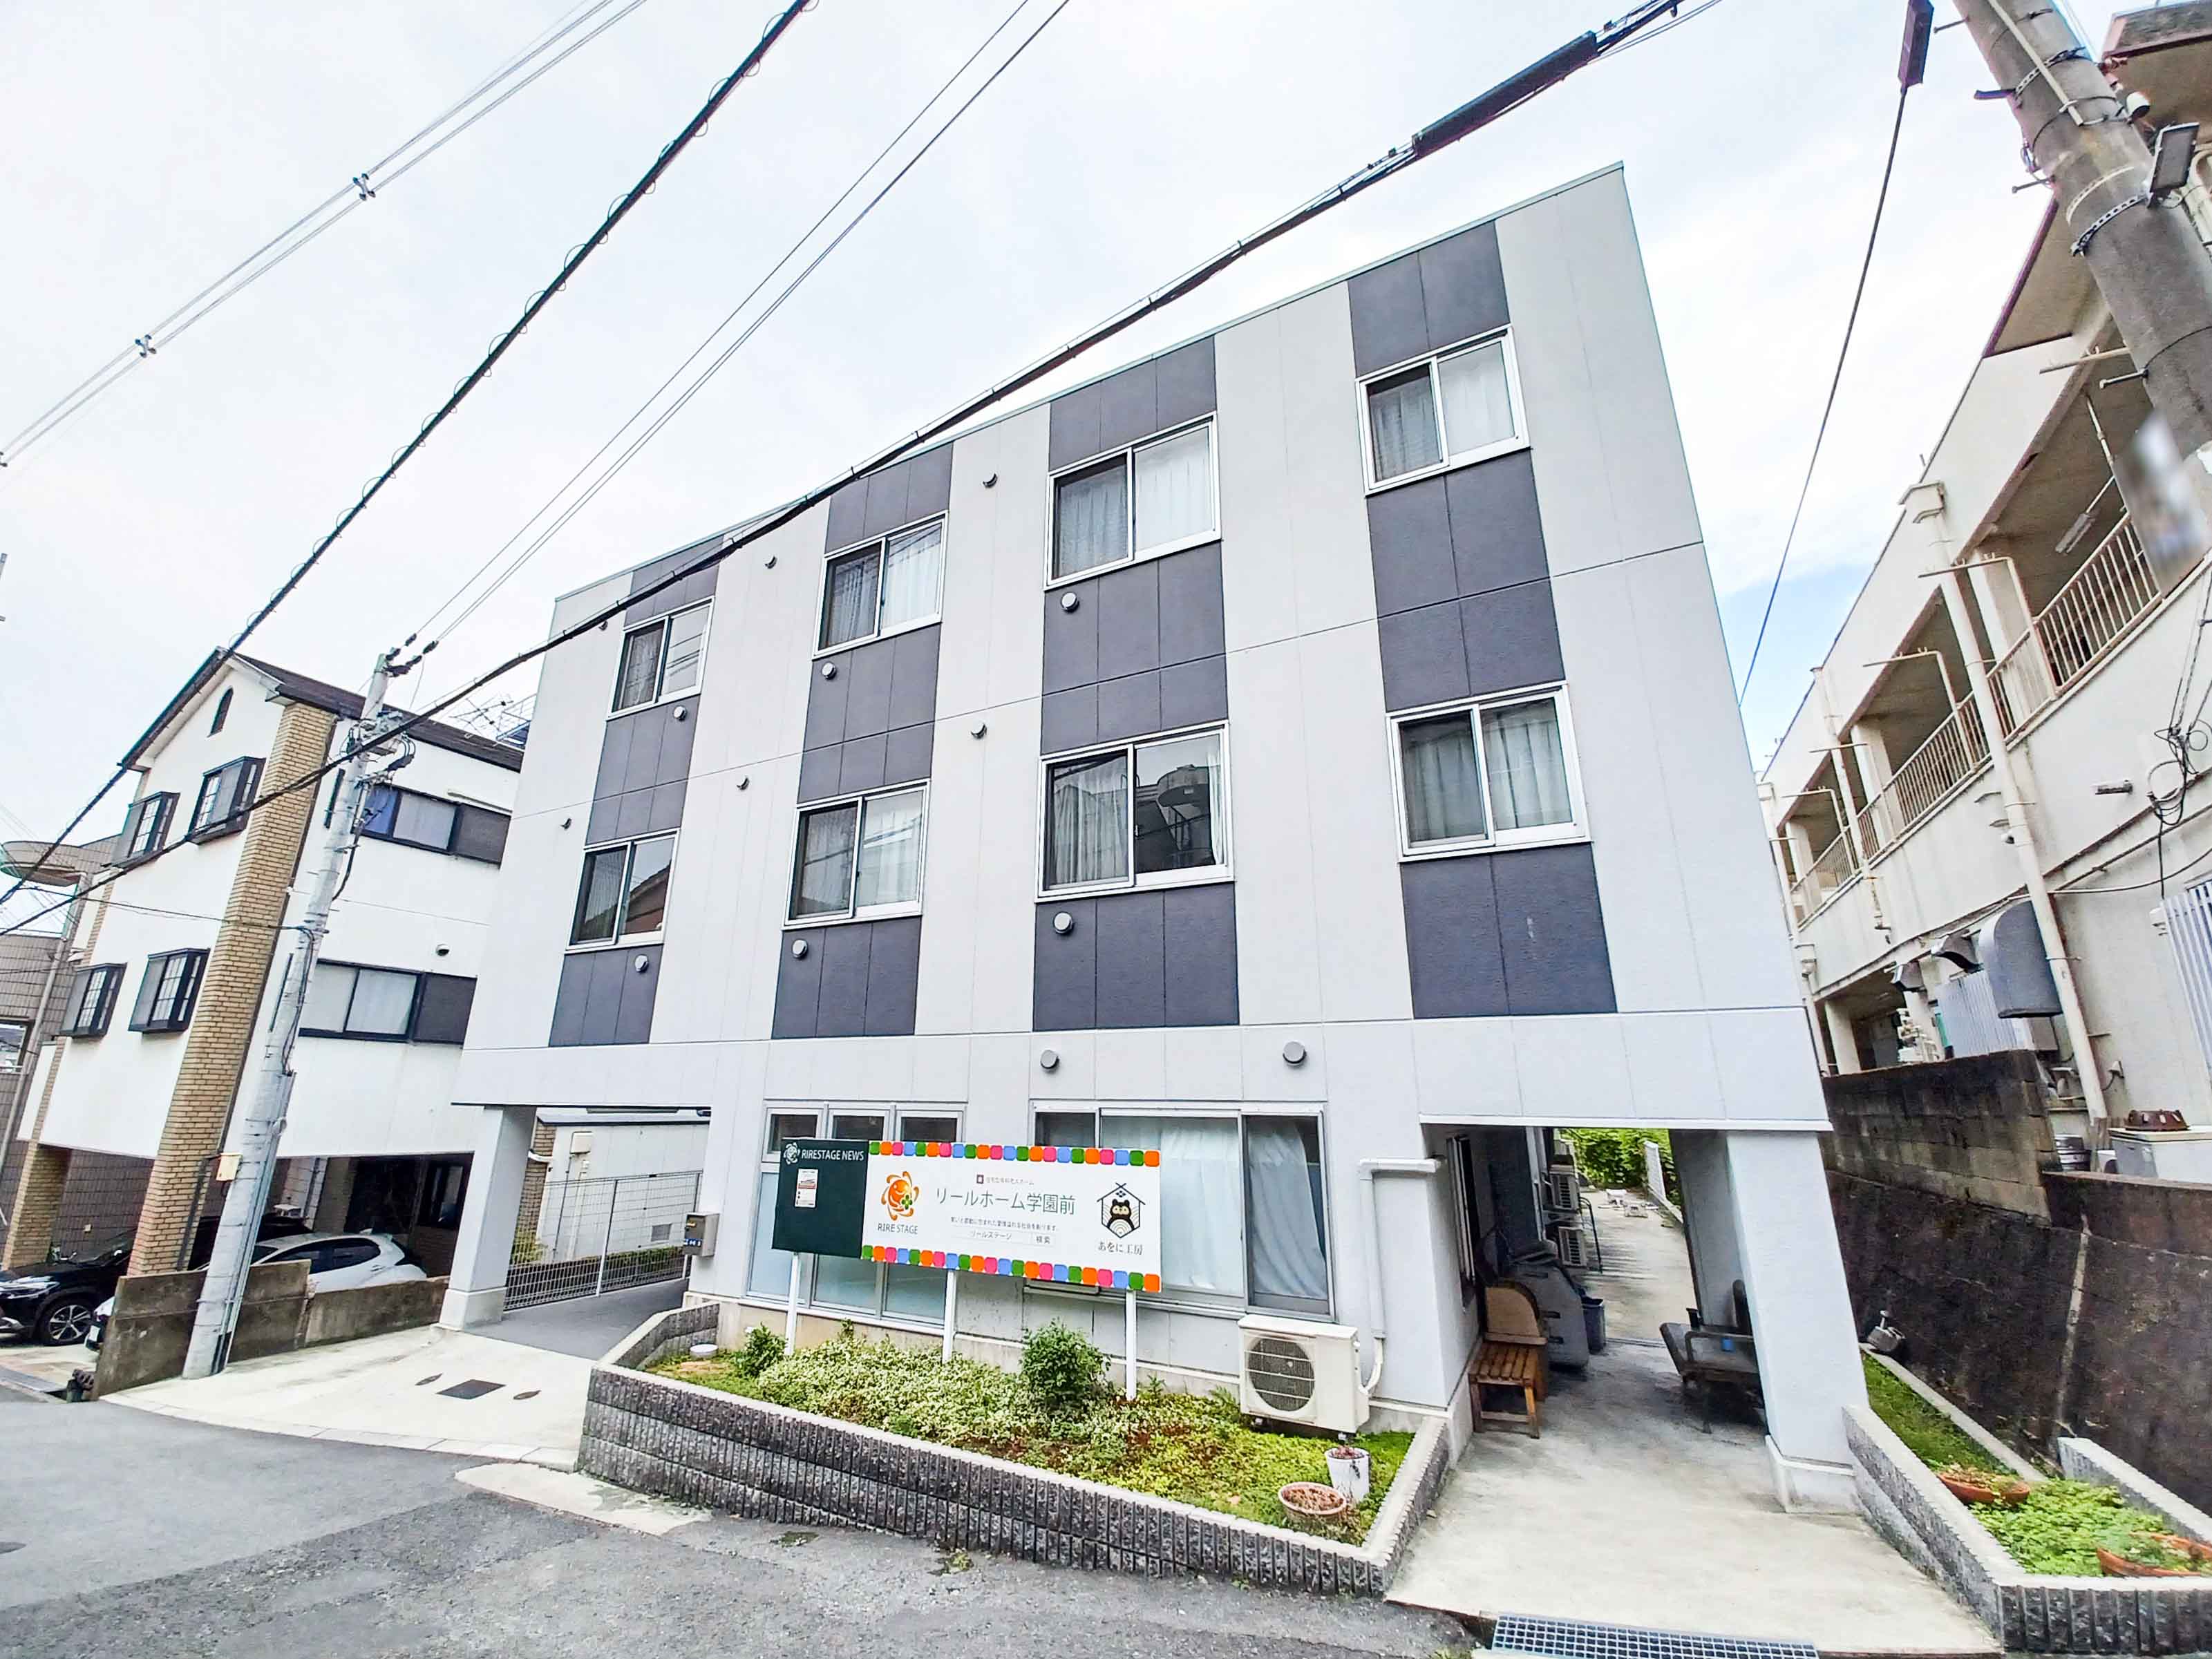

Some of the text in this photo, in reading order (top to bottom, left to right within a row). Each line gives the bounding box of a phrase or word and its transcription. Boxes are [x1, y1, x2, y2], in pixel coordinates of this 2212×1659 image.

[801, 1149, 864, 1162] RIRESTAGE NEWS
[936, 1188, 1076, 1215] リールホーム学園前
[878, 1223, 918, 1234] RIRE STAGE
